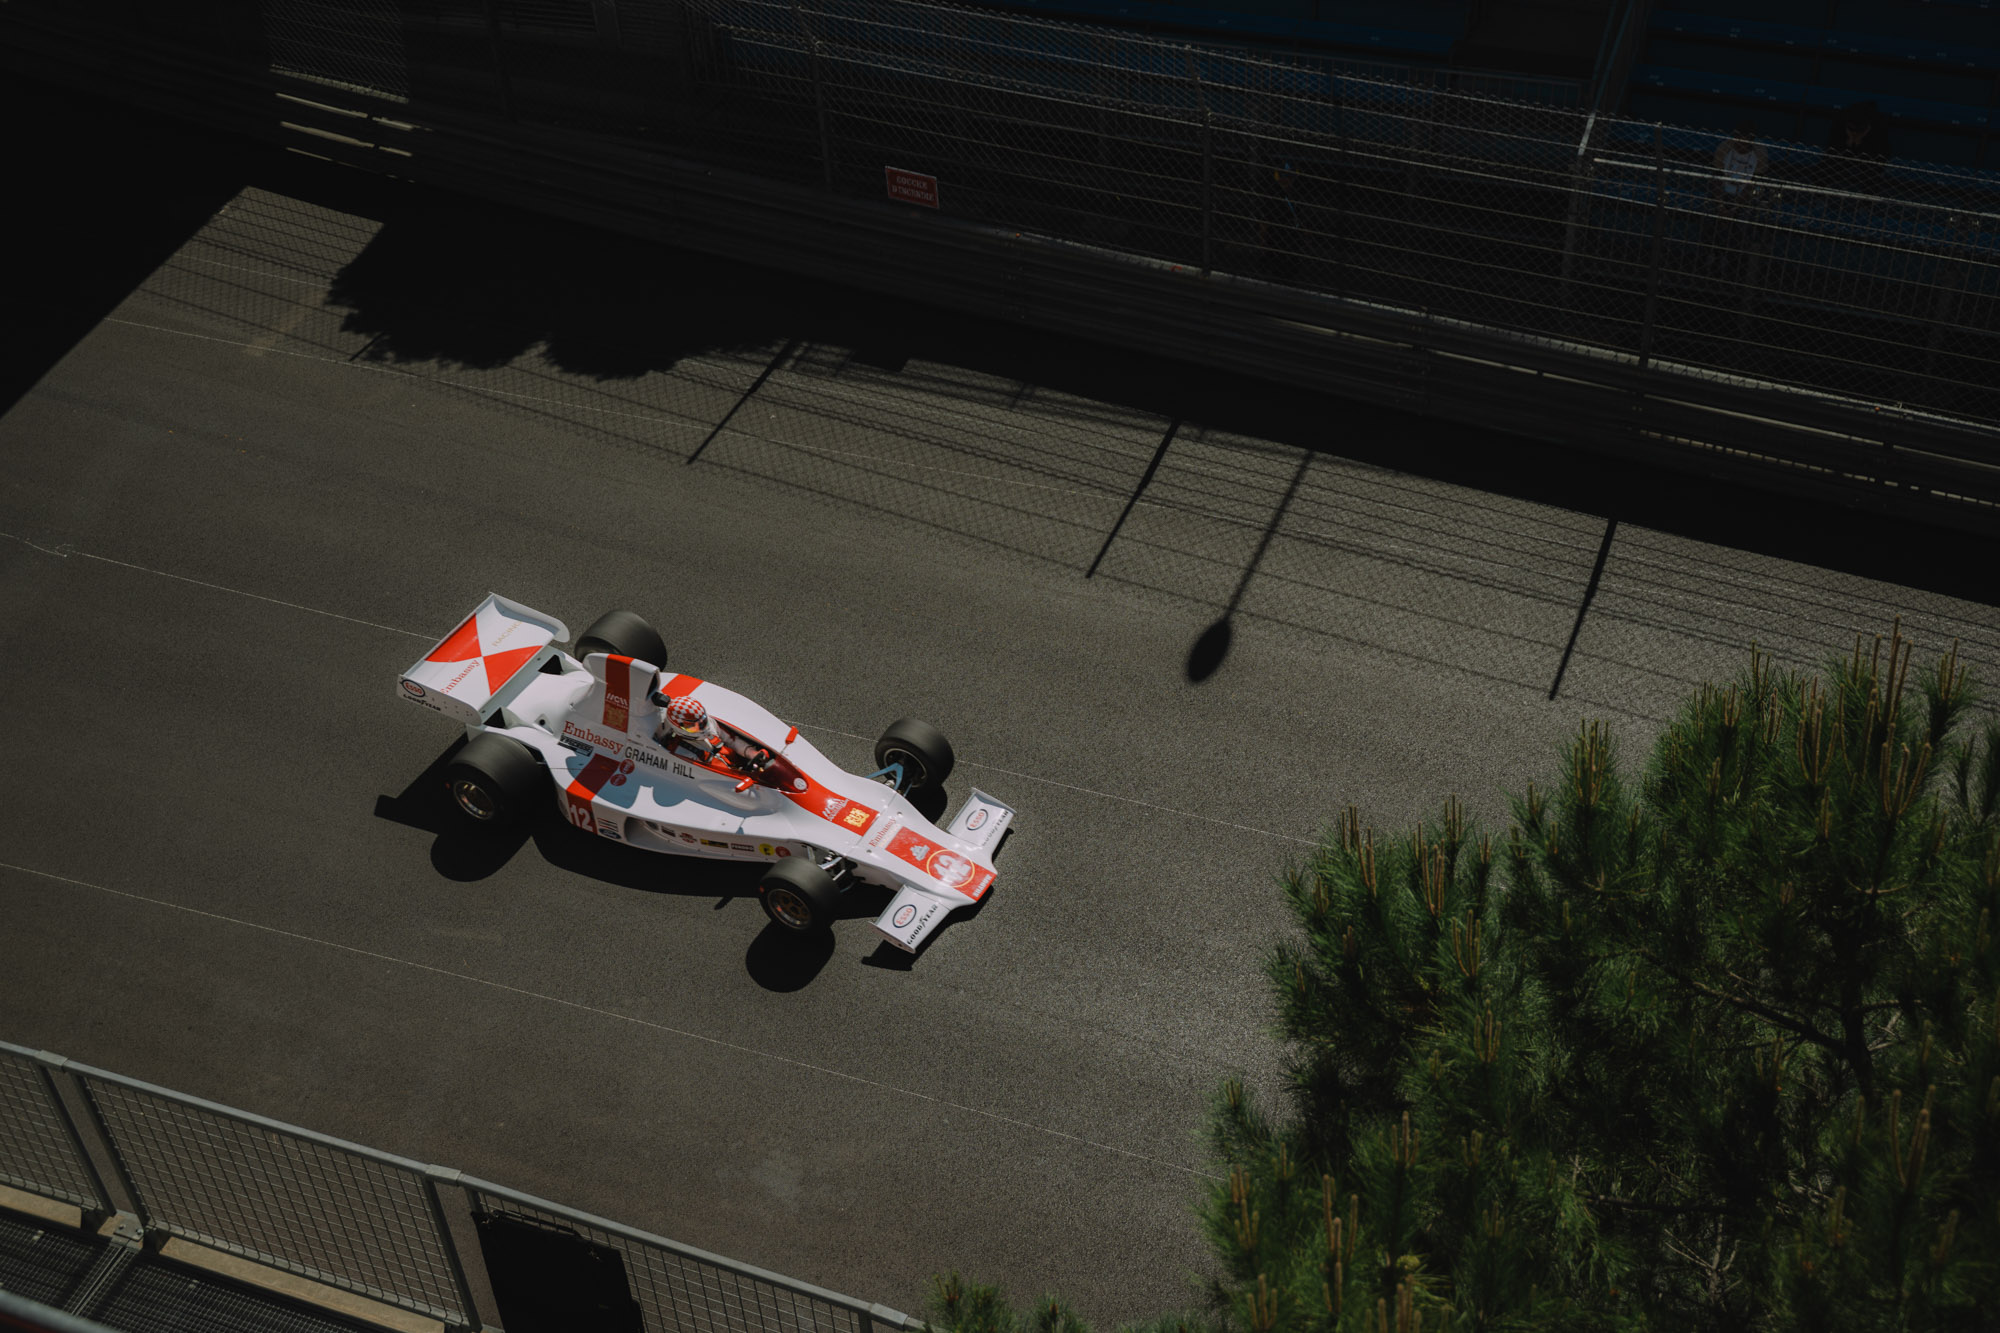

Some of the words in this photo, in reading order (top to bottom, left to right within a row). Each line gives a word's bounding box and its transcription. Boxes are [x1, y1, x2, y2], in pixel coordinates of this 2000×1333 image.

[440, 659, 480, 695] Embassy
[563, 720, 624, 755] Embassy
[624, 746, 668, 771] GRAHAM
[672, 762, 695, 779] HILL
[570, 804, 593, 832] 12
[868, 817, 896, 847] Embassy
[906, 904, 938, 945] GOODYEAR
